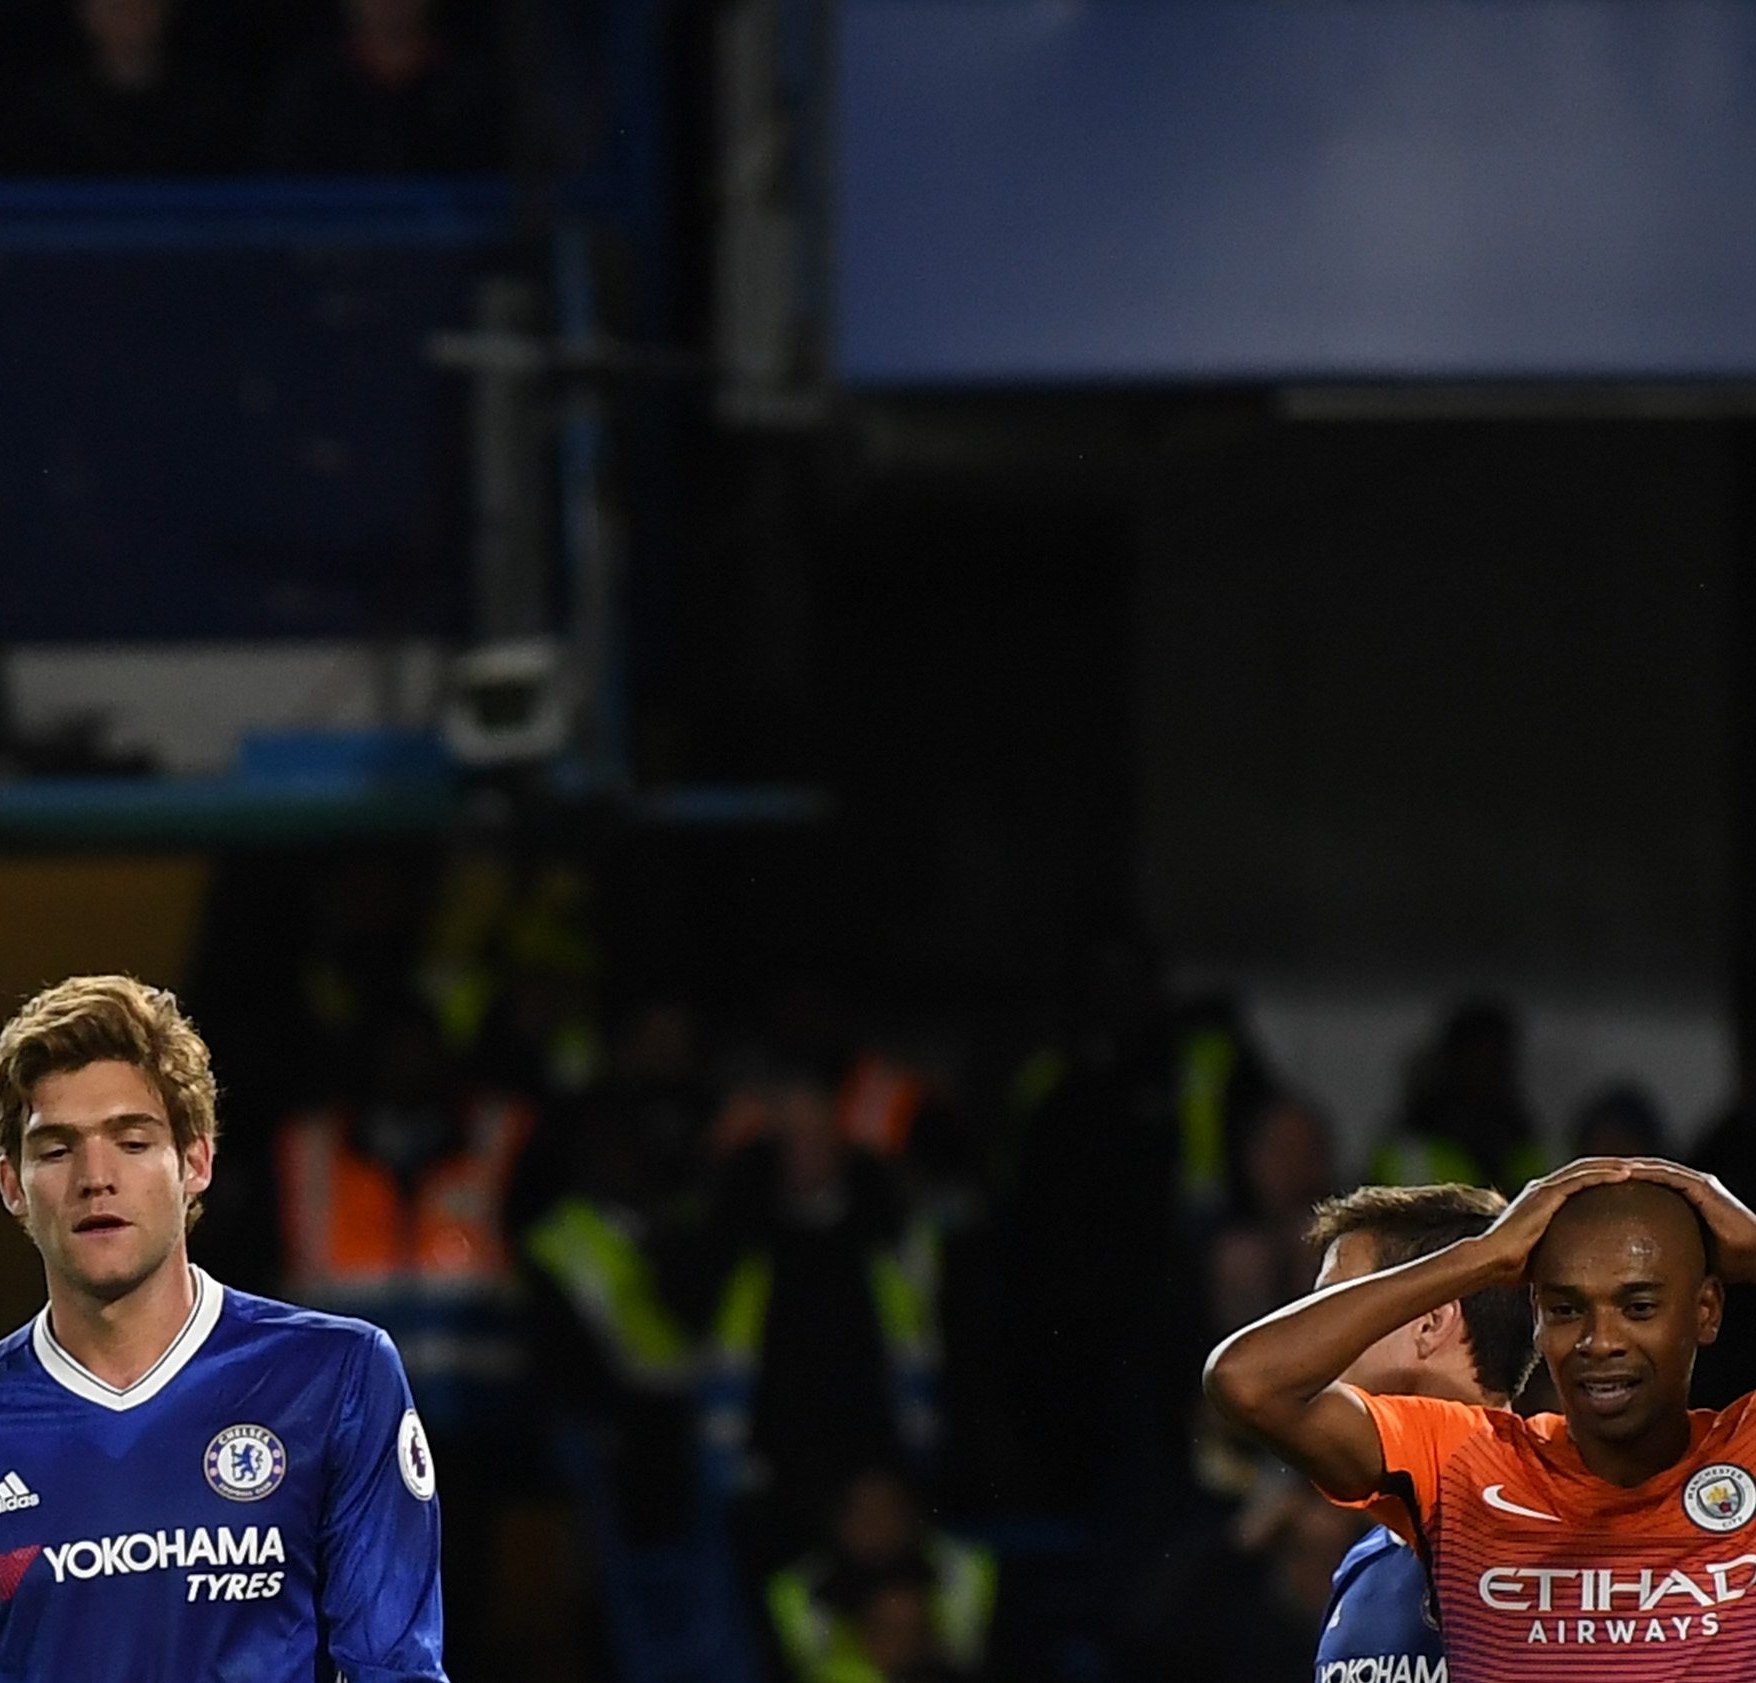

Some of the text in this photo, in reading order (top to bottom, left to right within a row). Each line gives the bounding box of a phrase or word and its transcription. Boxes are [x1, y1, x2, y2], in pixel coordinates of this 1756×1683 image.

[43, 1526, 286, 1583] YOKOHAMA
[186, 1571, 285, 1602] TYRES
[1527, 1612, 1720, 1644] AIRWAYS
